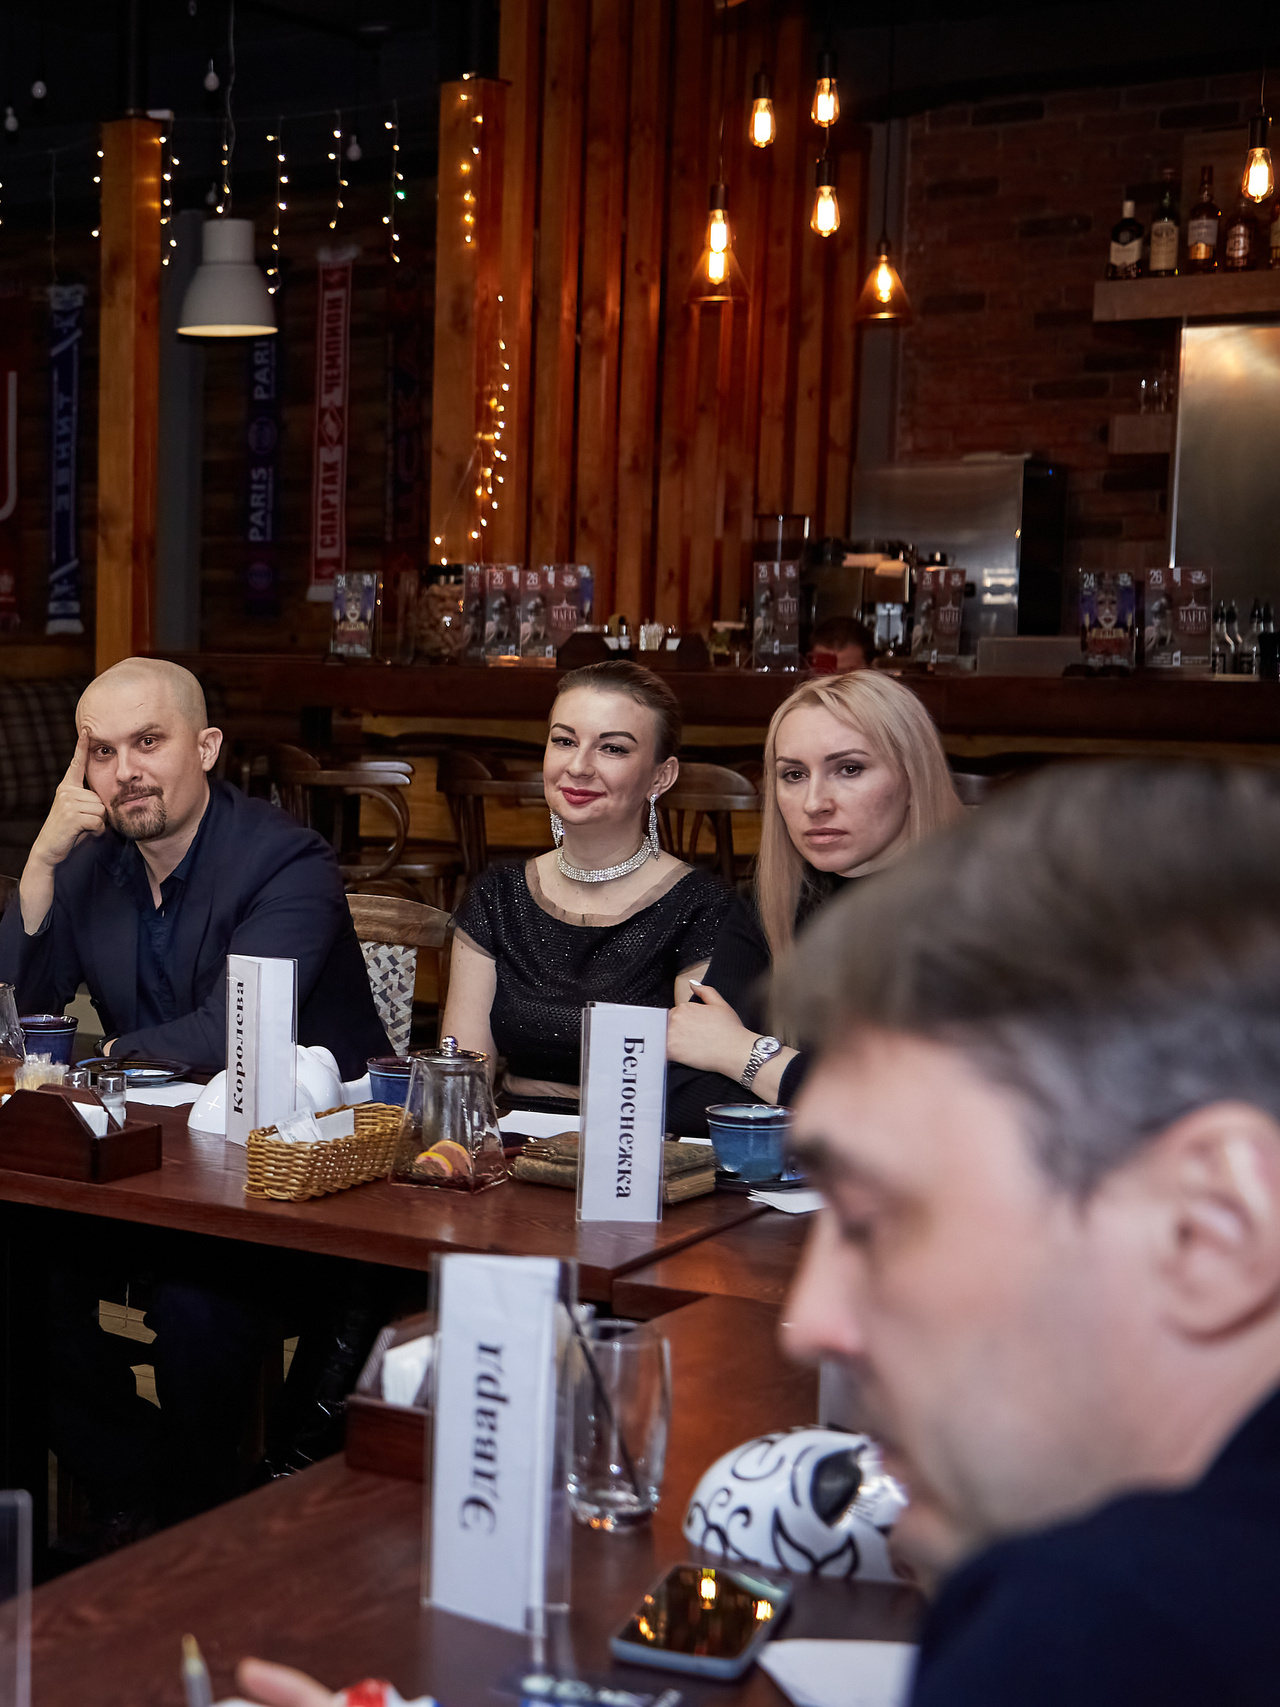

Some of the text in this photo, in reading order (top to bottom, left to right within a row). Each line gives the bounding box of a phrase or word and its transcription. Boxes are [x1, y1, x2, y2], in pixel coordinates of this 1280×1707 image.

[325, 298, 342, 394] ЧЕМПИОН
[248, 466, 268, 542] PARIS
[320, 460, 340, 549] СПАРТАК
[1083, 573, 1095, 589] 24
[1149, 569, 1163, 585] 26
[233, 982, 246, 1115] Королева
[616, 1035, 646, 1199] Белоснежка
